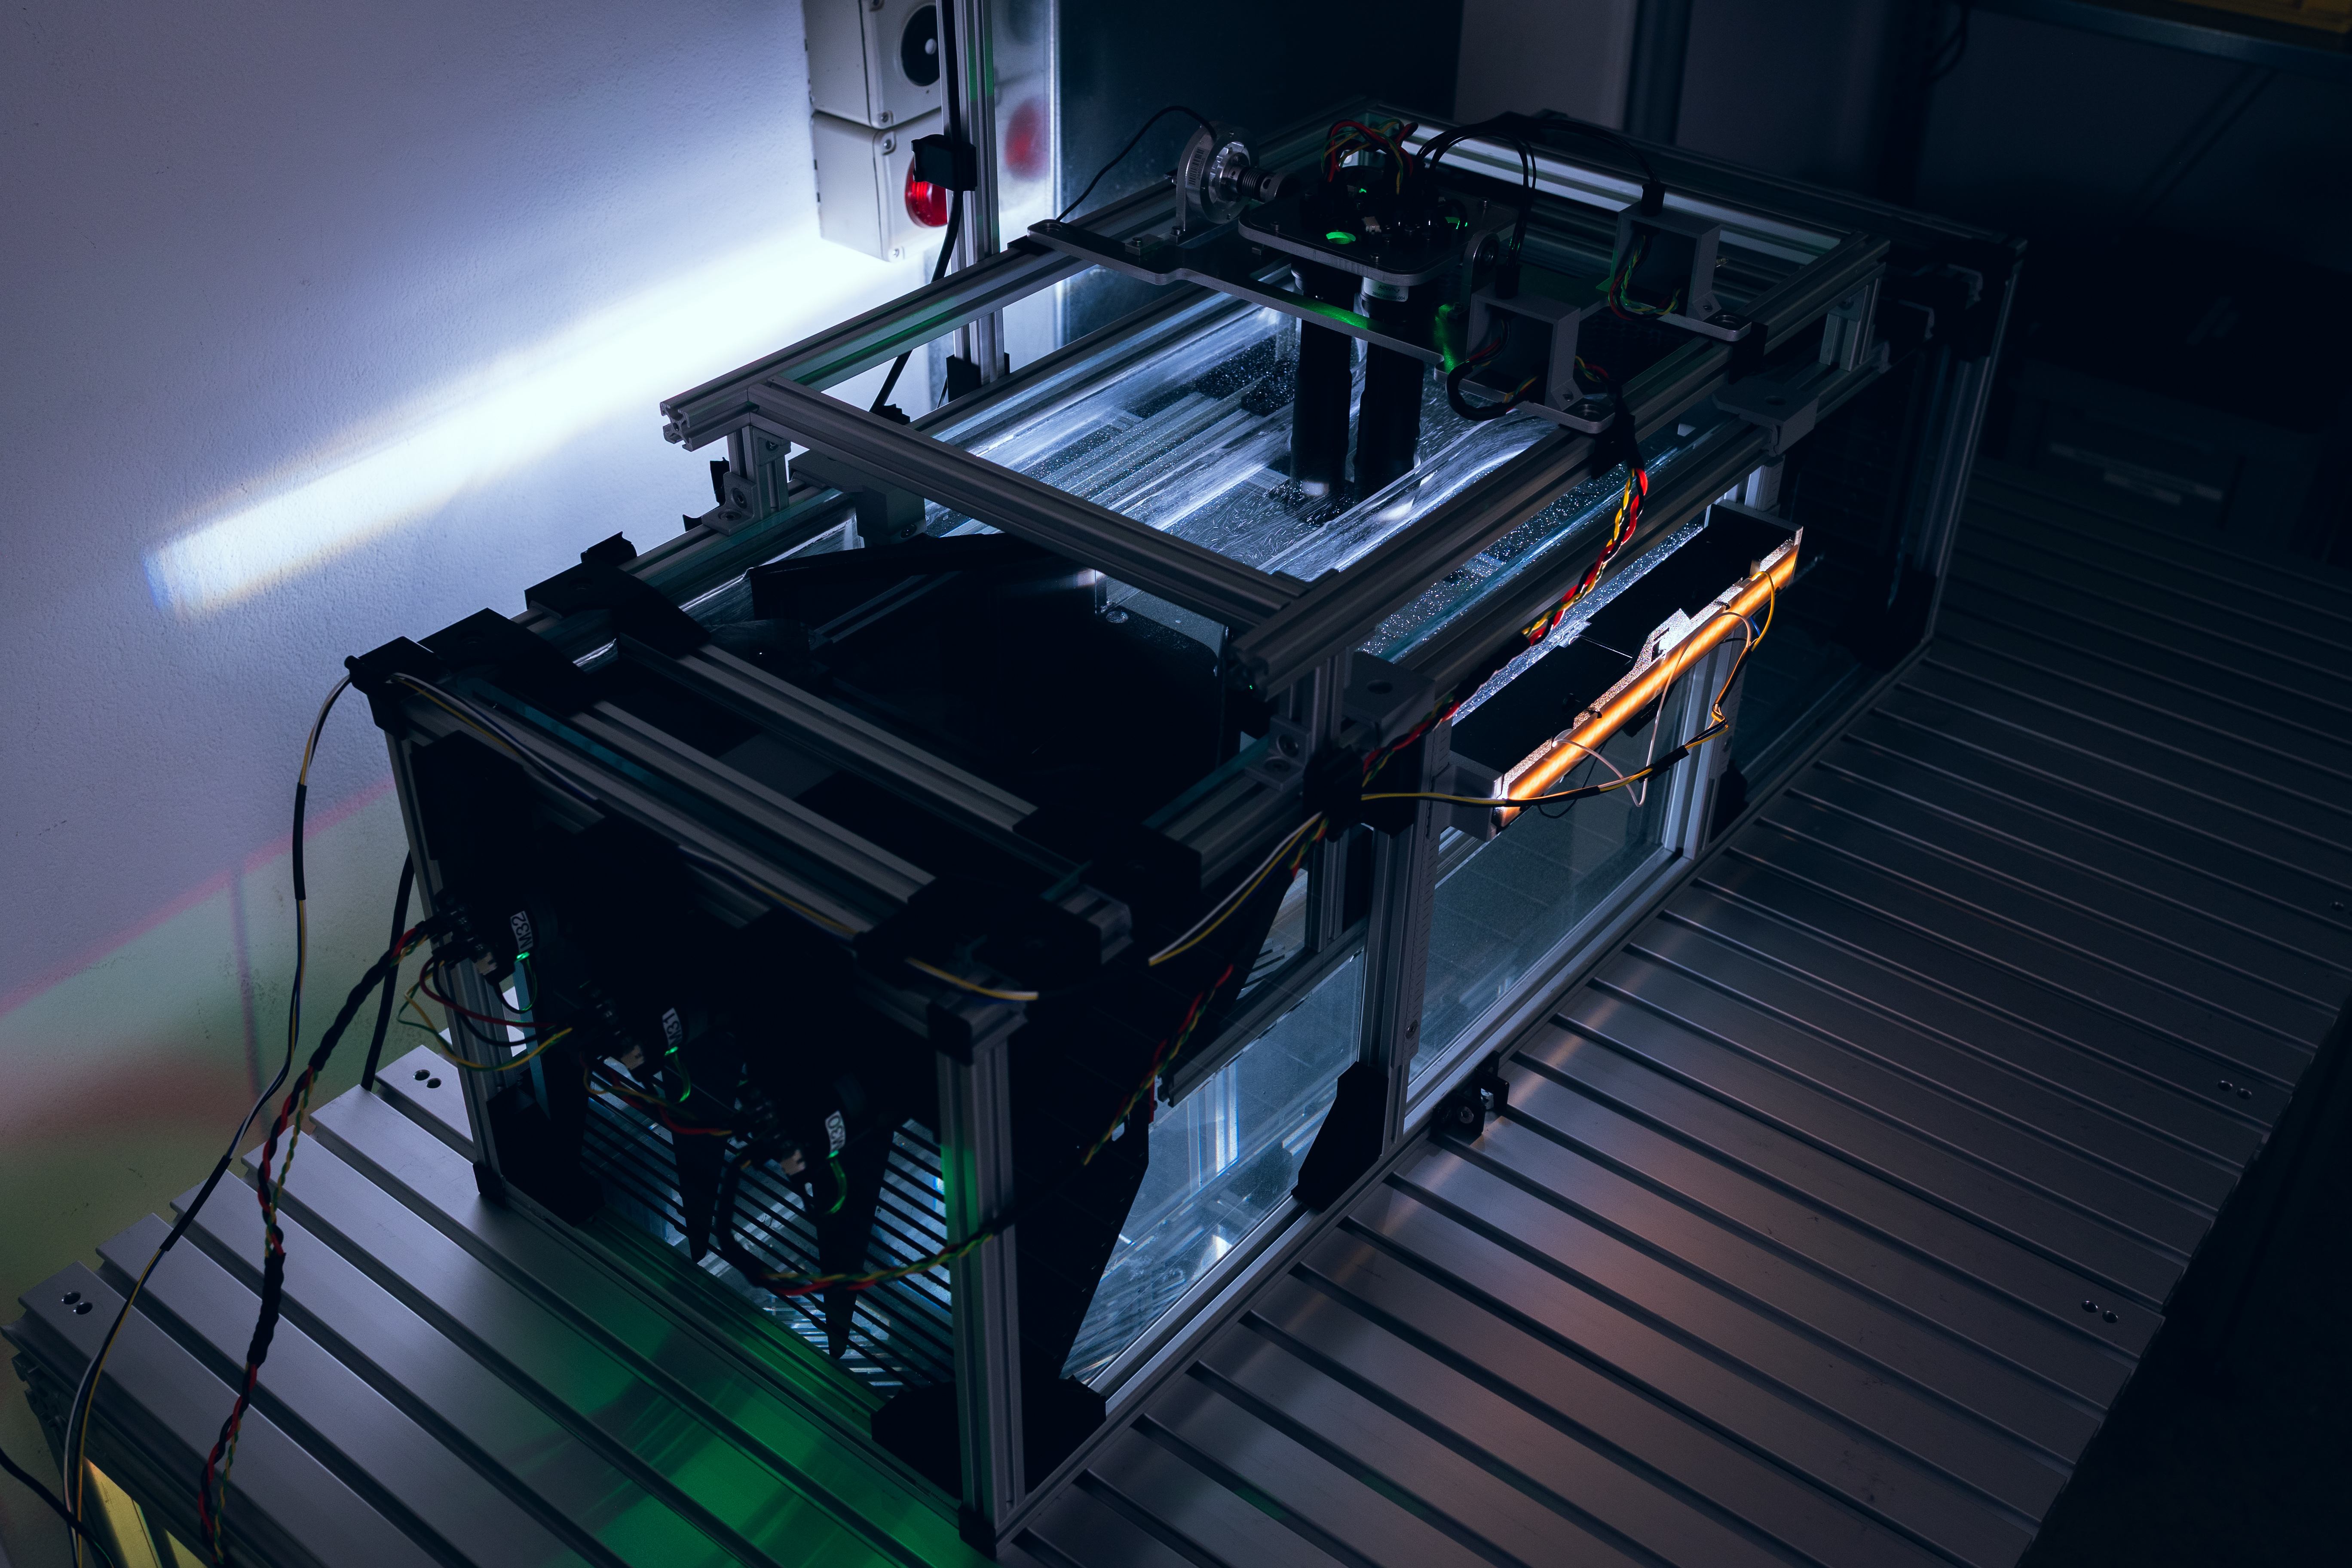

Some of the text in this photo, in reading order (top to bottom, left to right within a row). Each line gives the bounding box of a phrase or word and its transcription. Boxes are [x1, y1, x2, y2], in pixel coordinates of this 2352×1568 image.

[511, 912, 533, 949] M32
[663, 1013, 682, 1046] M31
[827, 1115, 843, 1150] M30
